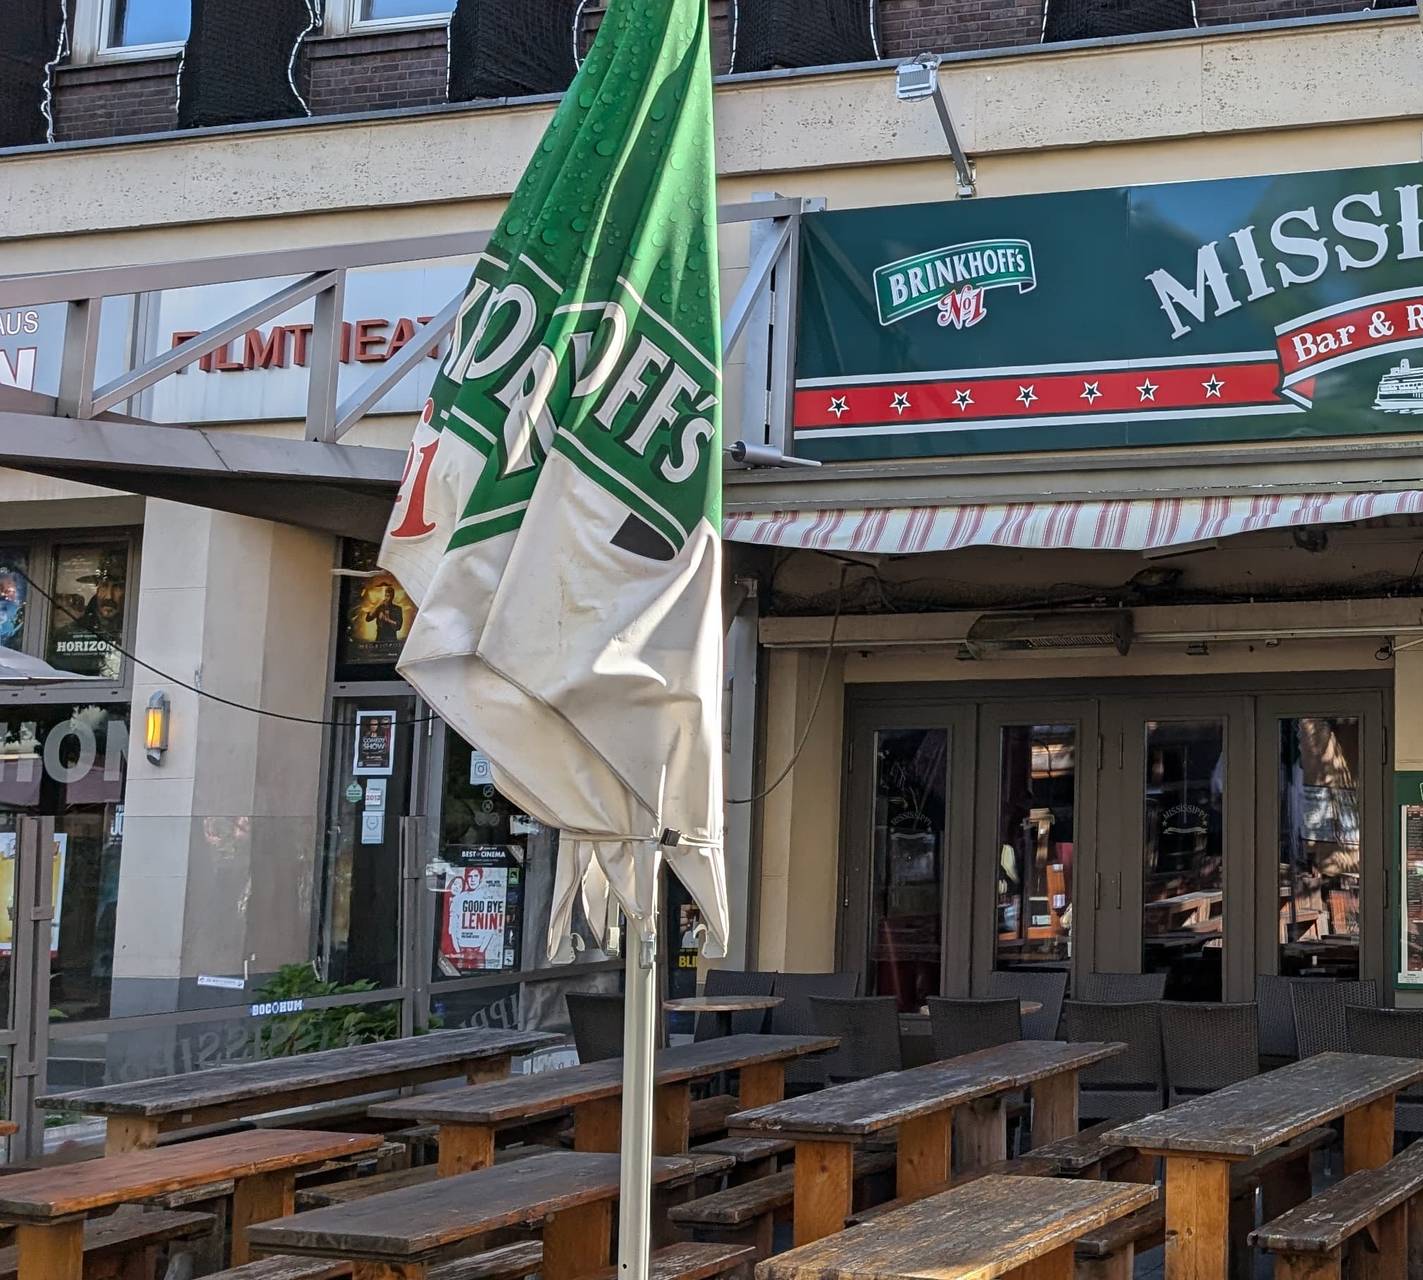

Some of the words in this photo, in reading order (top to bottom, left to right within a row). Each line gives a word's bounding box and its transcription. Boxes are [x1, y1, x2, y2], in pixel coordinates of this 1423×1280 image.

[1291, 325, 1356, 363] Bar
[1367, 310, 1395, 339] &
[56, 641, 115, 652] HORIZON
[461, 850, 477, 858] BEST
[480, 850, 506, 858] CINEMA
[462, 900, 485, 913] GOOD
[487, 901, 504, 913] BYE
